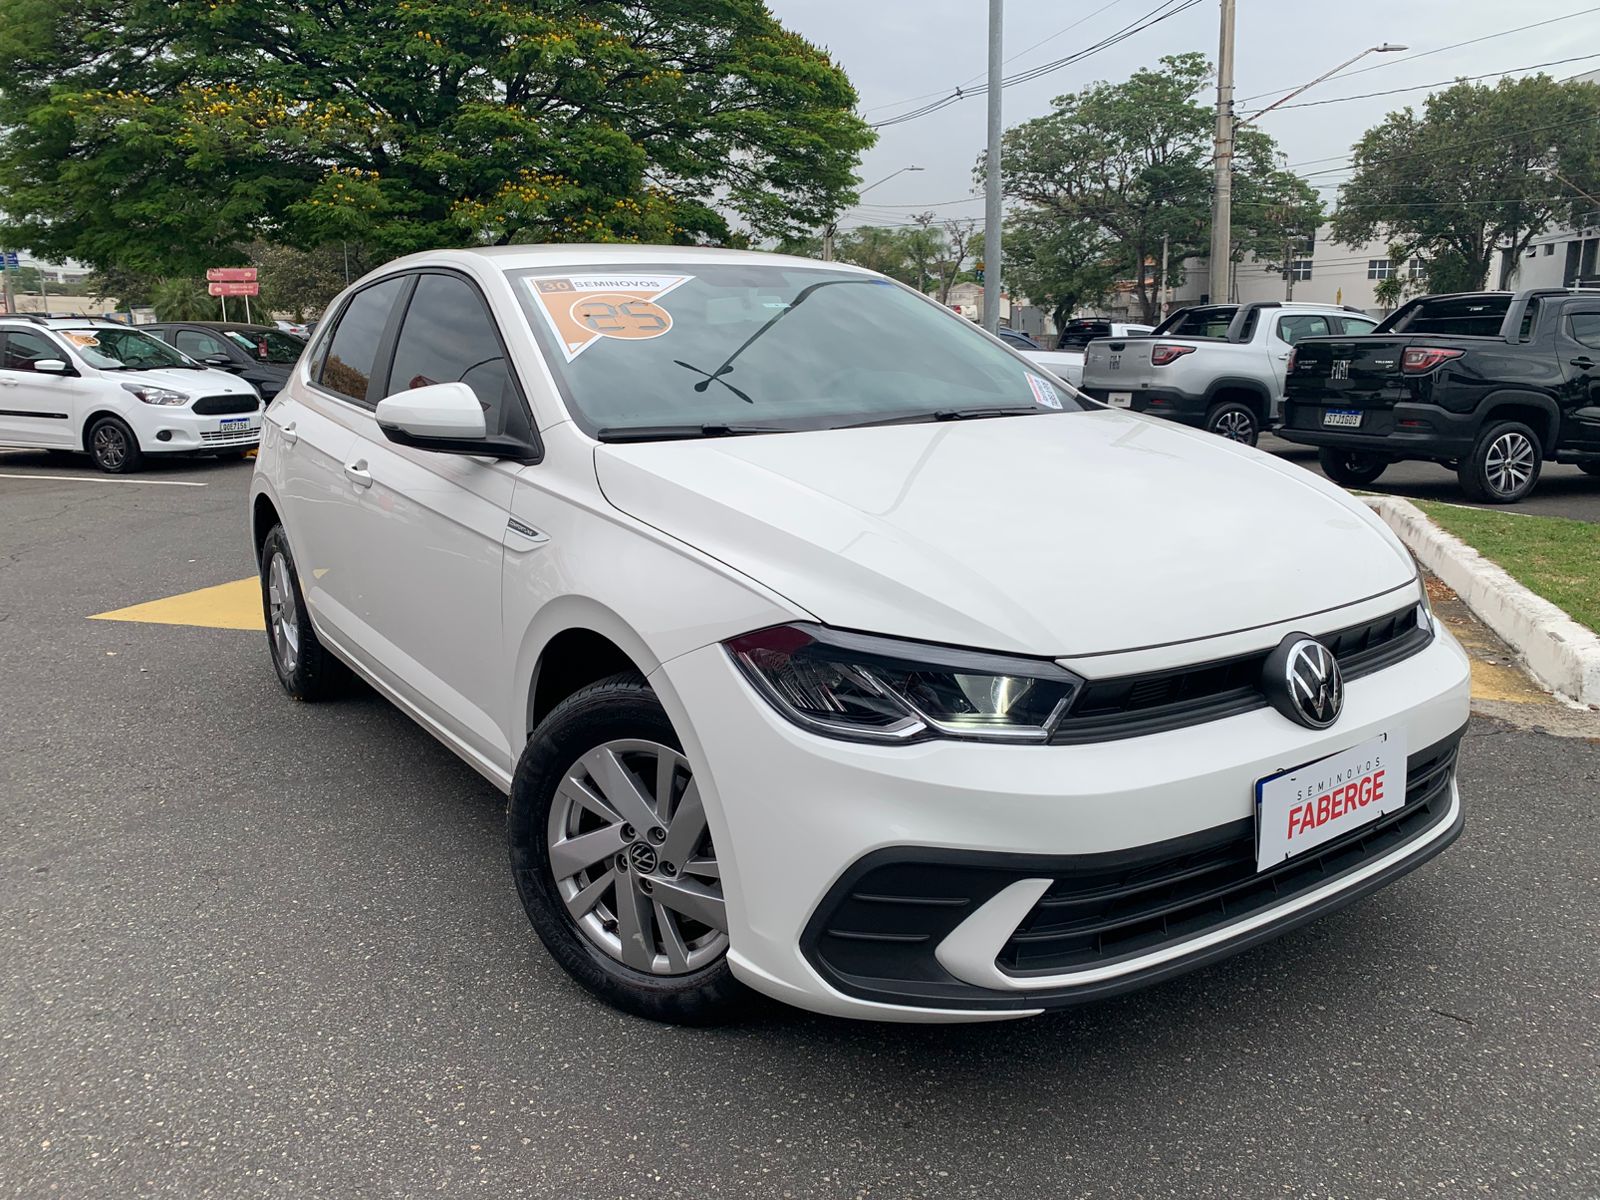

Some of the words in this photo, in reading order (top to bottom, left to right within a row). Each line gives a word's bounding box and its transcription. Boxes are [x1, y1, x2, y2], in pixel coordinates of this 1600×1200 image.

[574, 279, 661, 288] SEMINOVOS
[580, 300, 668, 332] 25
[1331, 359, 1352, 379] FIAT
[1297, 756, 1381, 801] SEMINOVOS
[1287, 769, 1386, 840] FABERGE
